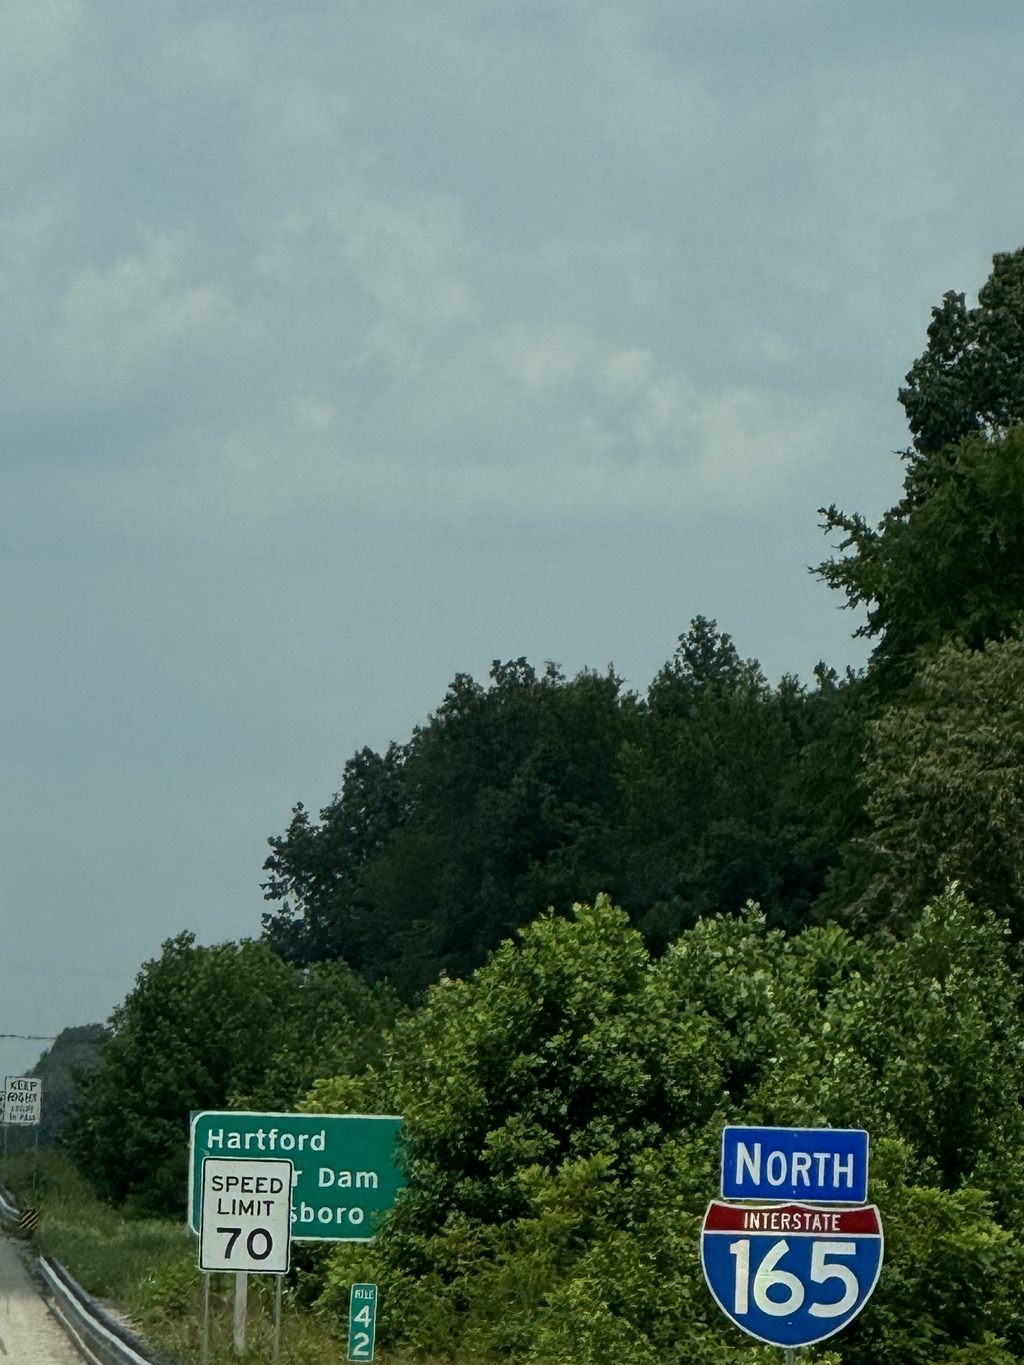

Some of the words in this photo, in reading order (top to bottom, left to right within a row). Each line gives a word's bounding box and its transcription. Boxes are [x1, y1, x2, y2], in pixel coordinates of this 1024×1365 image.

[207, 1128, 326, 1151] Hartford
[735, 1142, 854, 1188] NORTH
[211, 1175, 284, 1194] SPEED
[318, 1167, 379, 1189] Dam
[216, 1198, 275, 1217] LIMIT
[291, 1201, 365, 1225] sboro
[743, 1212, 841, 1231] INTERSTATE
[216, 1227, 274, 1261] 70
[729, 1239, 859, 1318] 165
